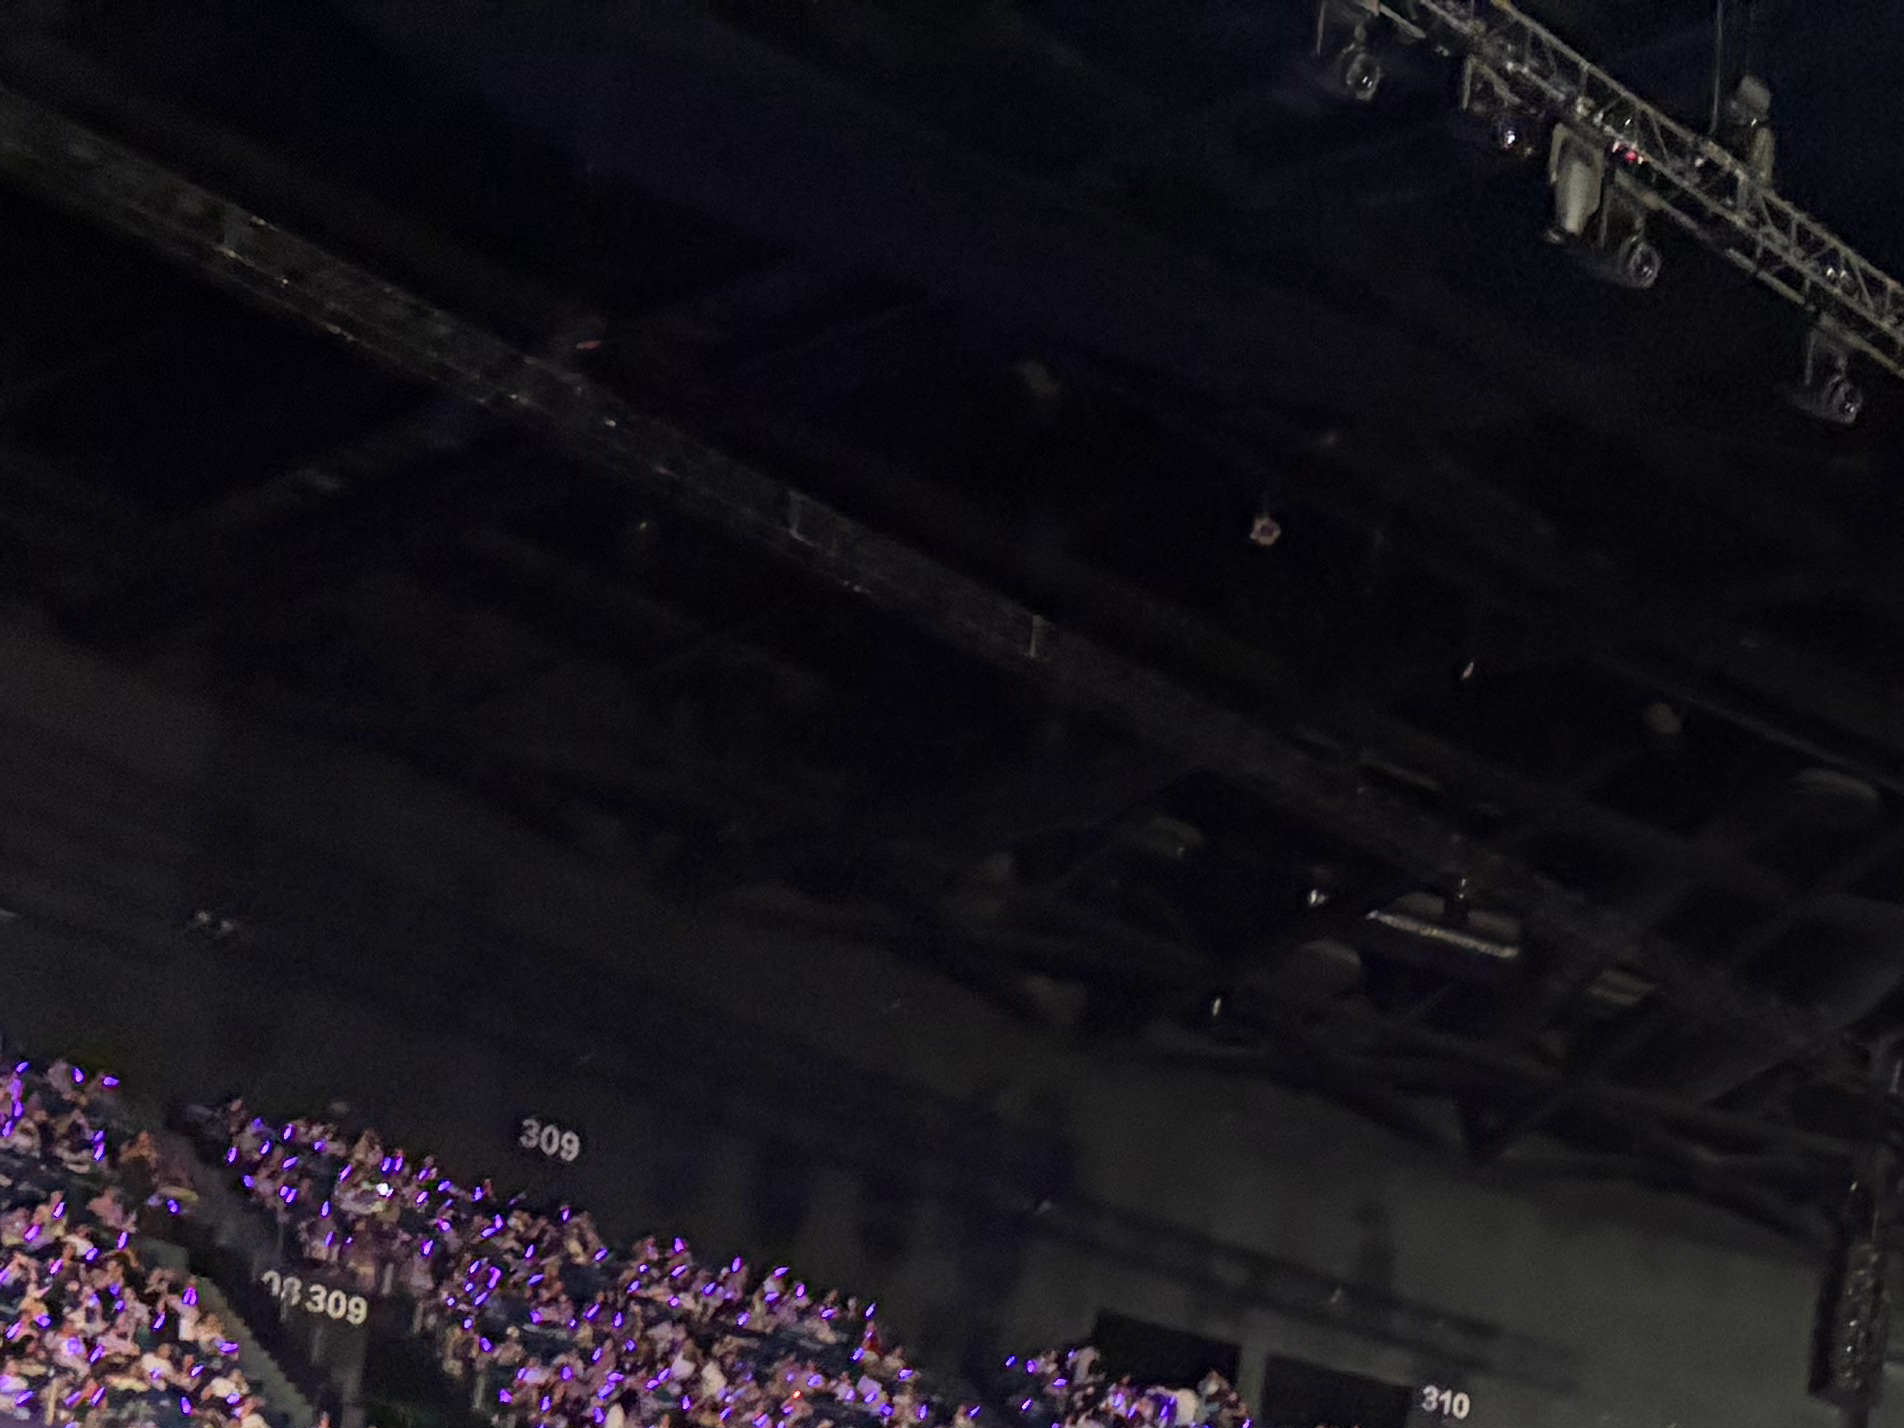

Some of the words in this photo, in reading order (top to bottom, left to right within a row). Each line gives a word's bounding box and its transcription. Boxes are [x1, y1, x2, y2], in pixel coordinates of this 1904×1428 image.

[520, 1118, 580, 1161] 309
[305, 1284, 368, 1325] 309
[1421, 1384, 1470, 1420] 310
